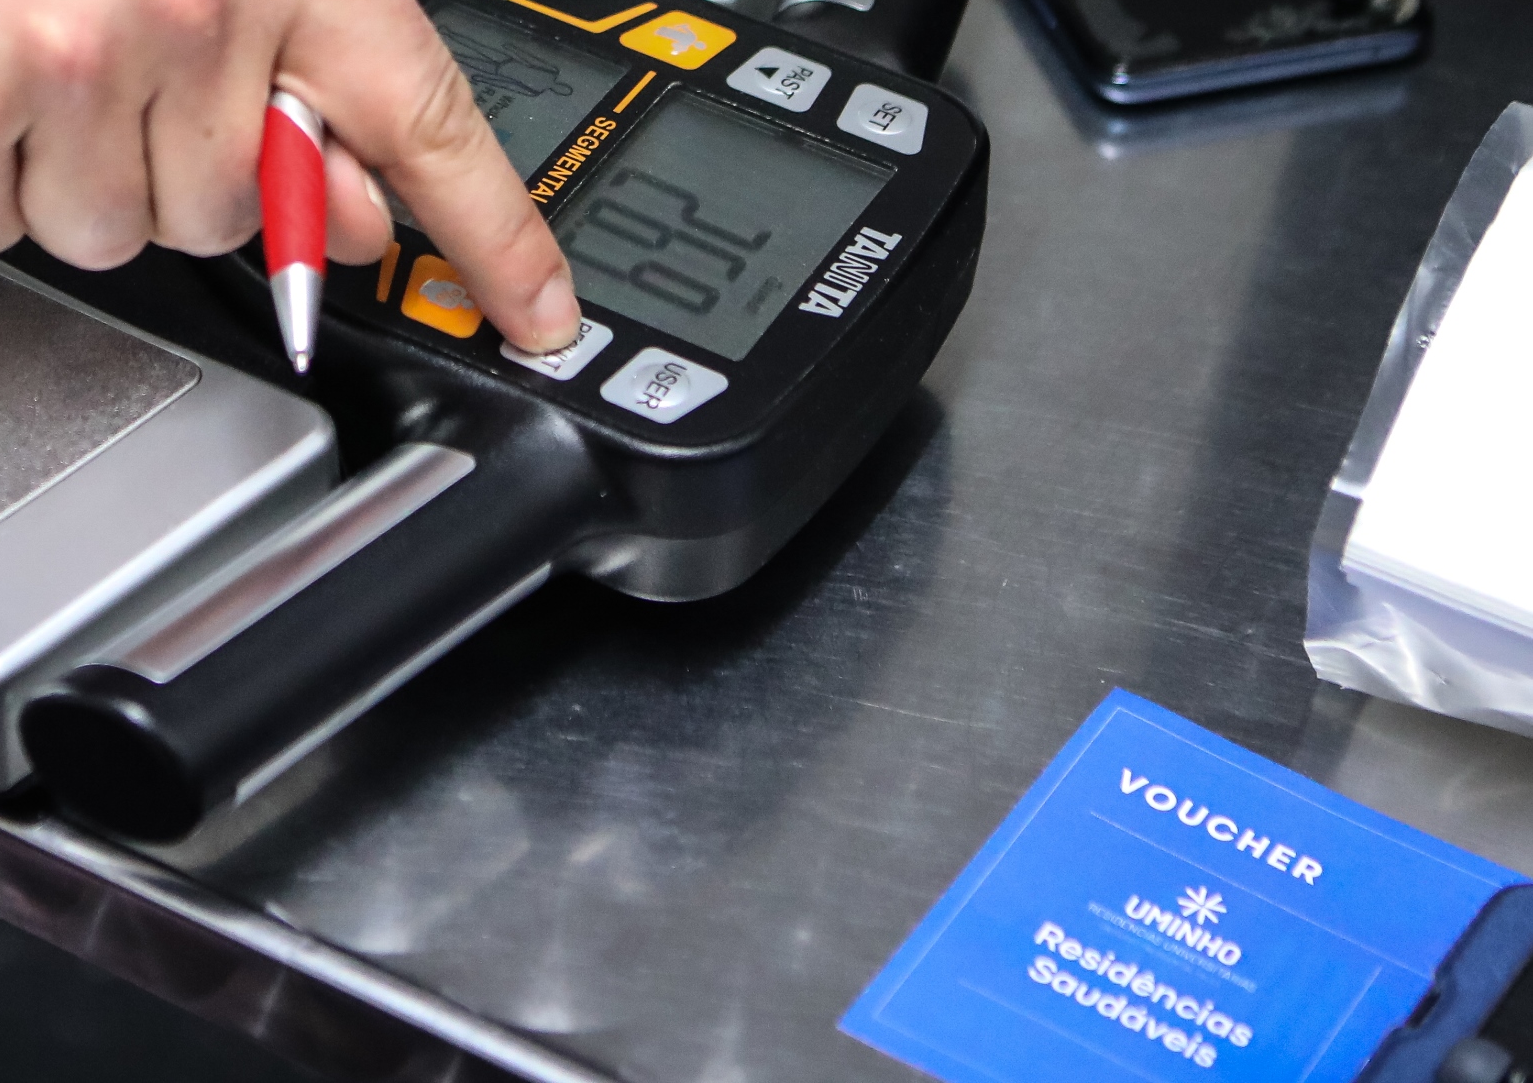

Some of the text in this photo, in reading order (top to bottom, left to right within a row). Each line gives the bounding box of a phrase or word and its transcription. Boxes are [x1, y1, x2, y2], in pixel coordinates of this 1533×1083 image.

[775, 65, 814, 100] PAST
[868, 101, 903, 132] SET
[798, 226, 903, 318] TANITA
[636, 362, 688, 410] USER
[1119, 767, 1324, 886] VOUCHER
[1124, 894, 1242, 966] UMINHO
[1027, 955, 1217, 1068] Saudáveis
[1034, 921, 1254, 1048] Residências
